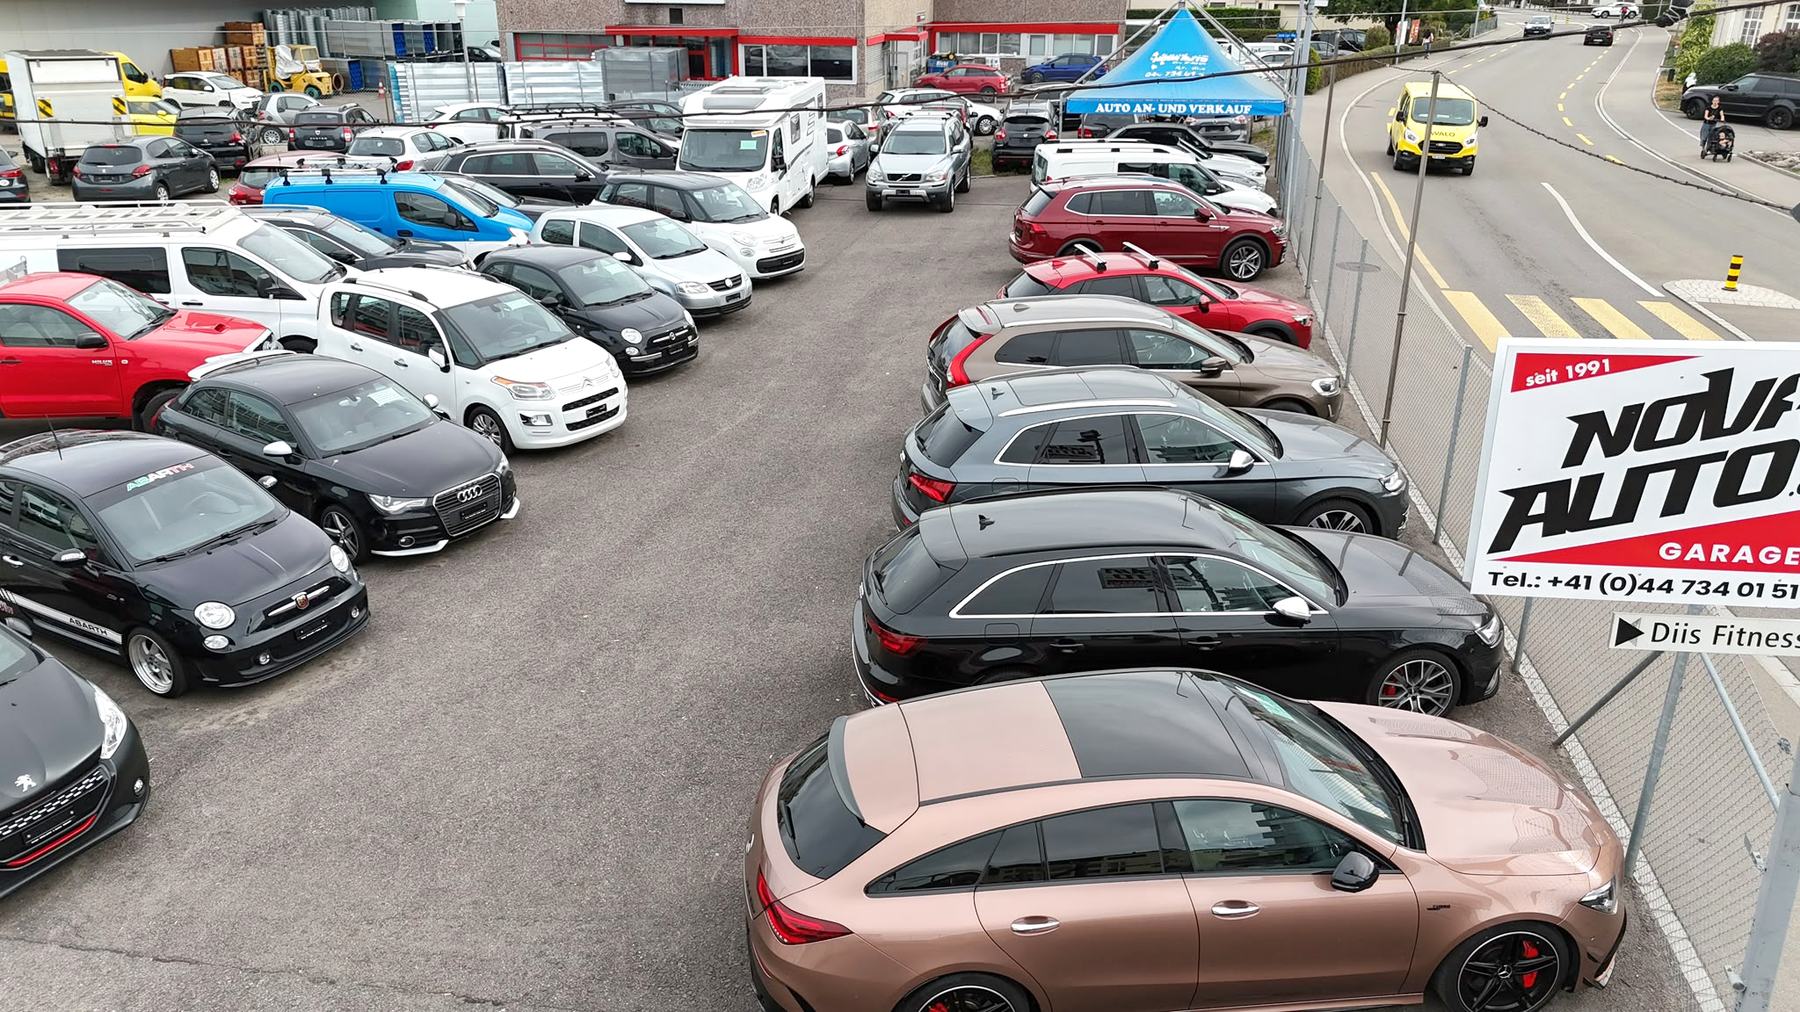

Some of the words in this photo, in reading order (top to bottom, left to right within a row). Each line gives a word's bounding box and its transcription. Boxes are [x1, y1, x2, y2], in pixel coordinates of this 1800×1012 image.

[1094, 103, 1131, 113] AUTO
[1132, 103, 1156, 113] AN-
[1158, 103, 1187, 113] UND
[1189, 104, 1253, 114] VERKAUF
[1525, 368, 1559, 387] seit
[1565, 358, 1611, 379] 1991
[126, 462, 195, 492] ABARTH
[1486, 438, 1800, 555] AUTO.
[1658, 541, 1800, 566] GARAGE
[1487, 571, 1542, 588] Tel.:
[1547, 574, 1593, 591] +41
[1599, 572, 1675, 597] (0)44
[1681, 579, 1731, 597] 734
[1736, 581, 1766, 598] 01
[1771, 583, 1800, 600] 51
[69, 617, 109, 637] ABARTH
[1650, 621, 1702, 645] Diis
